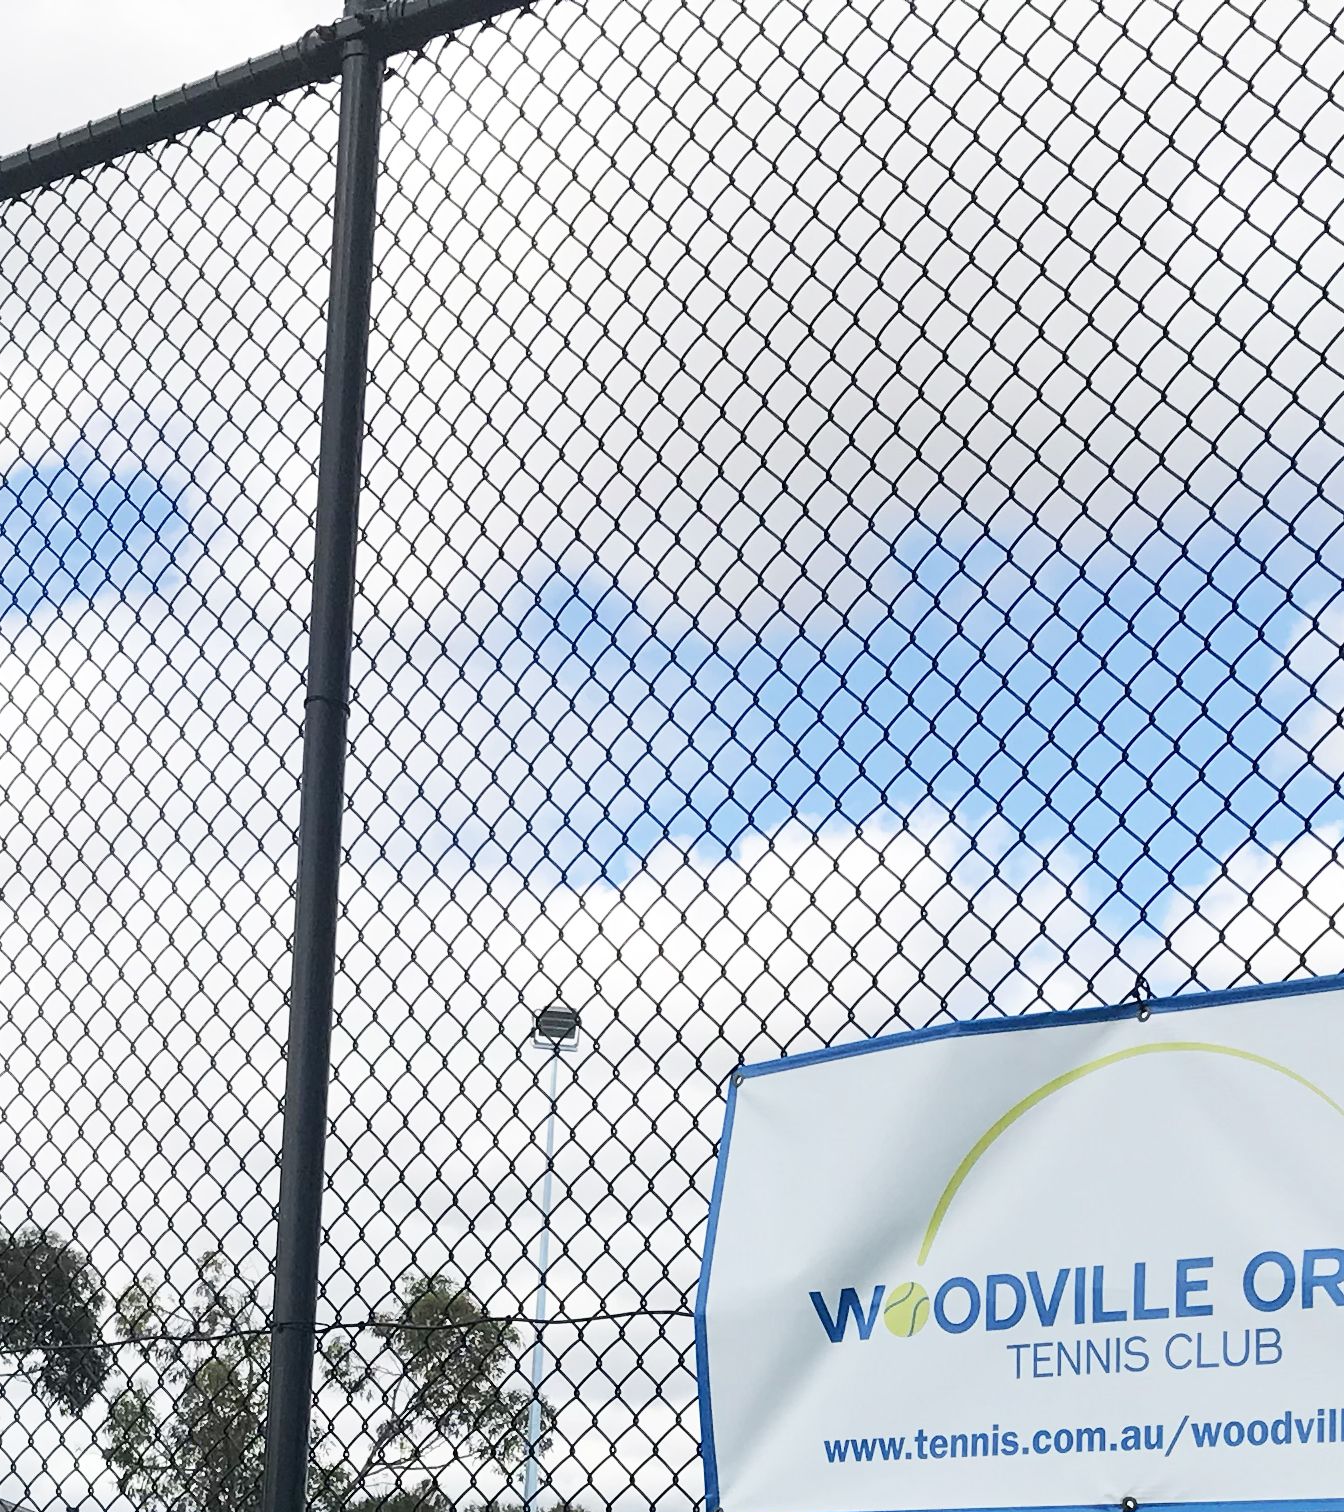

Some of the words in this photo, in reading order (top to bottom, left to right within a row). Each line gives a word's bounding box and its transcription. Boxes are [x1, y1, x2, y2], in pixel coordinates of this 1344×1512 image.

[809, 1256, 1214, 1344] WOODVILLE
[1007, 1335, 1150, 1379] TENNIS
[1165, 1327, 1283, 1370] CLUB
